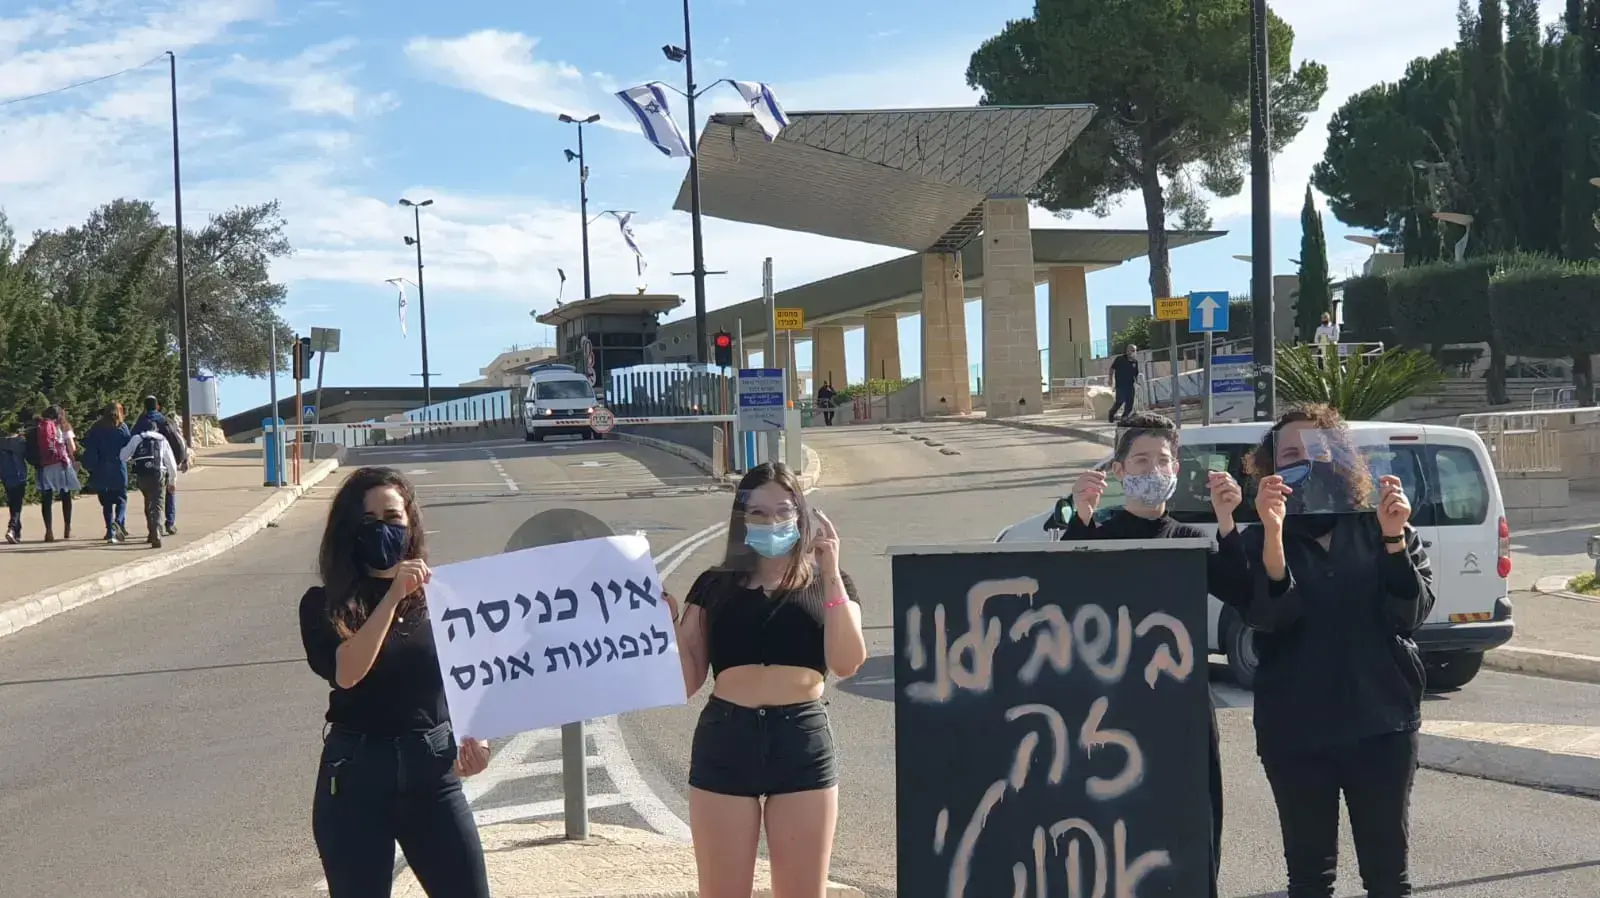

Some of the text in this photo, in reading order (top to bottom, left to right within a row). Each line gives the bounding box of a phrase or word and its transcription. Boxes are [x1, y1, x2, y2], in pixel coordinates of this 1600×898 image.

[441, 576, 657, 642] אין כניסה
[904, 576, 1193, 702] בשבילנו
[450, 624, 668, 690] לנפגעות אונס
[1003, 695, 1143, 801] זה
